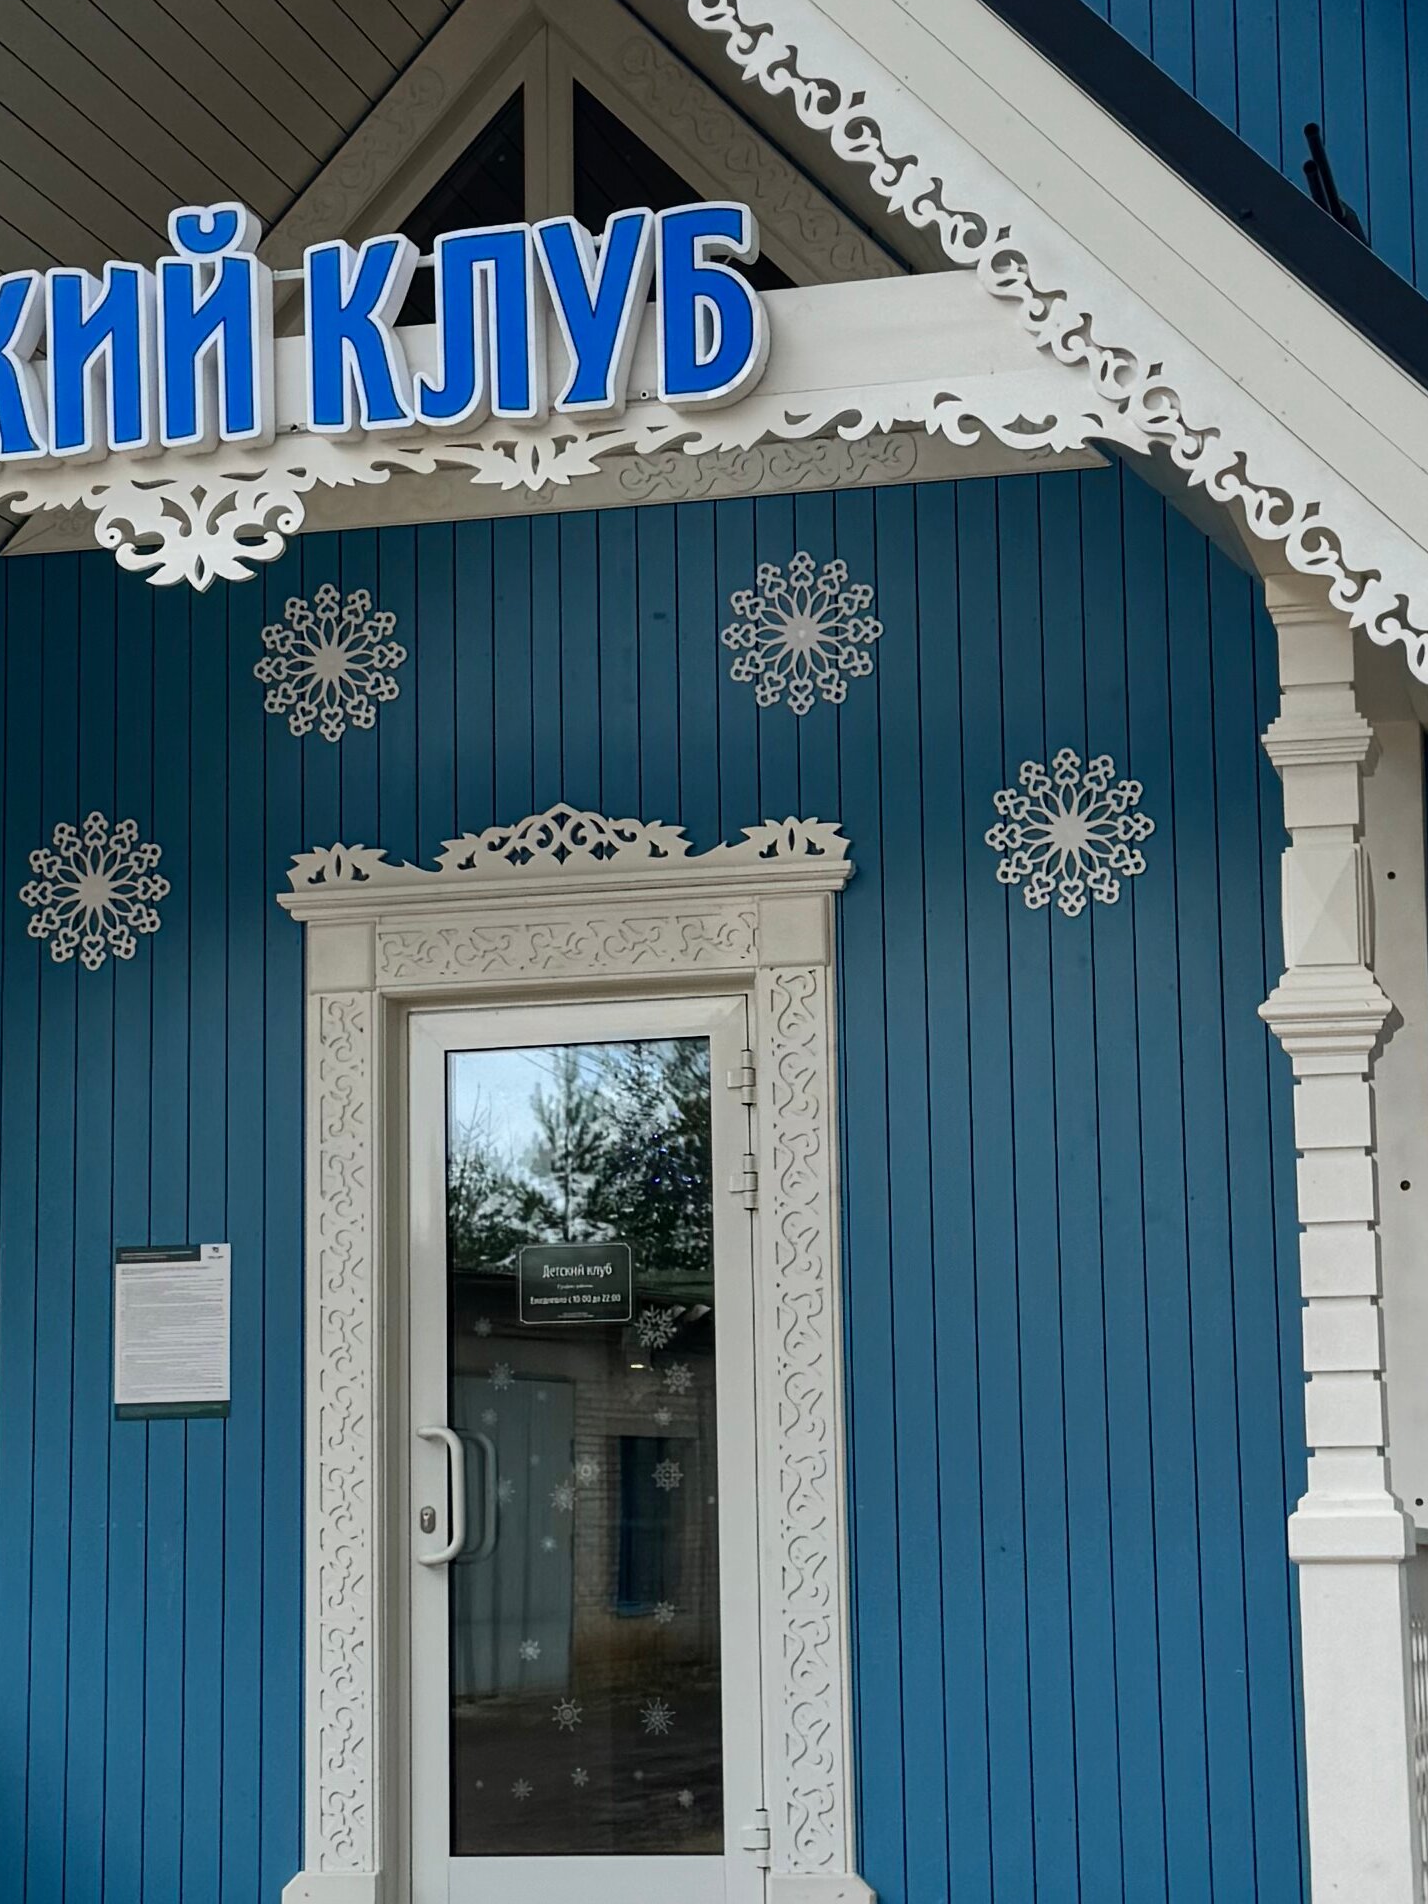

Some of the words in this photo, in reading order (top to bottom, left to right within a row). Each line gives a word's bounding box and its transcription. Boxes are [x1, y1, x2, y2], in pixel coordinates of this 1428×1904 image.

[305, 201, 770, 434] КЛУБ
[542, 1264, 584, 1278] Детский
[586, 1263, 612, 1278] клуб
